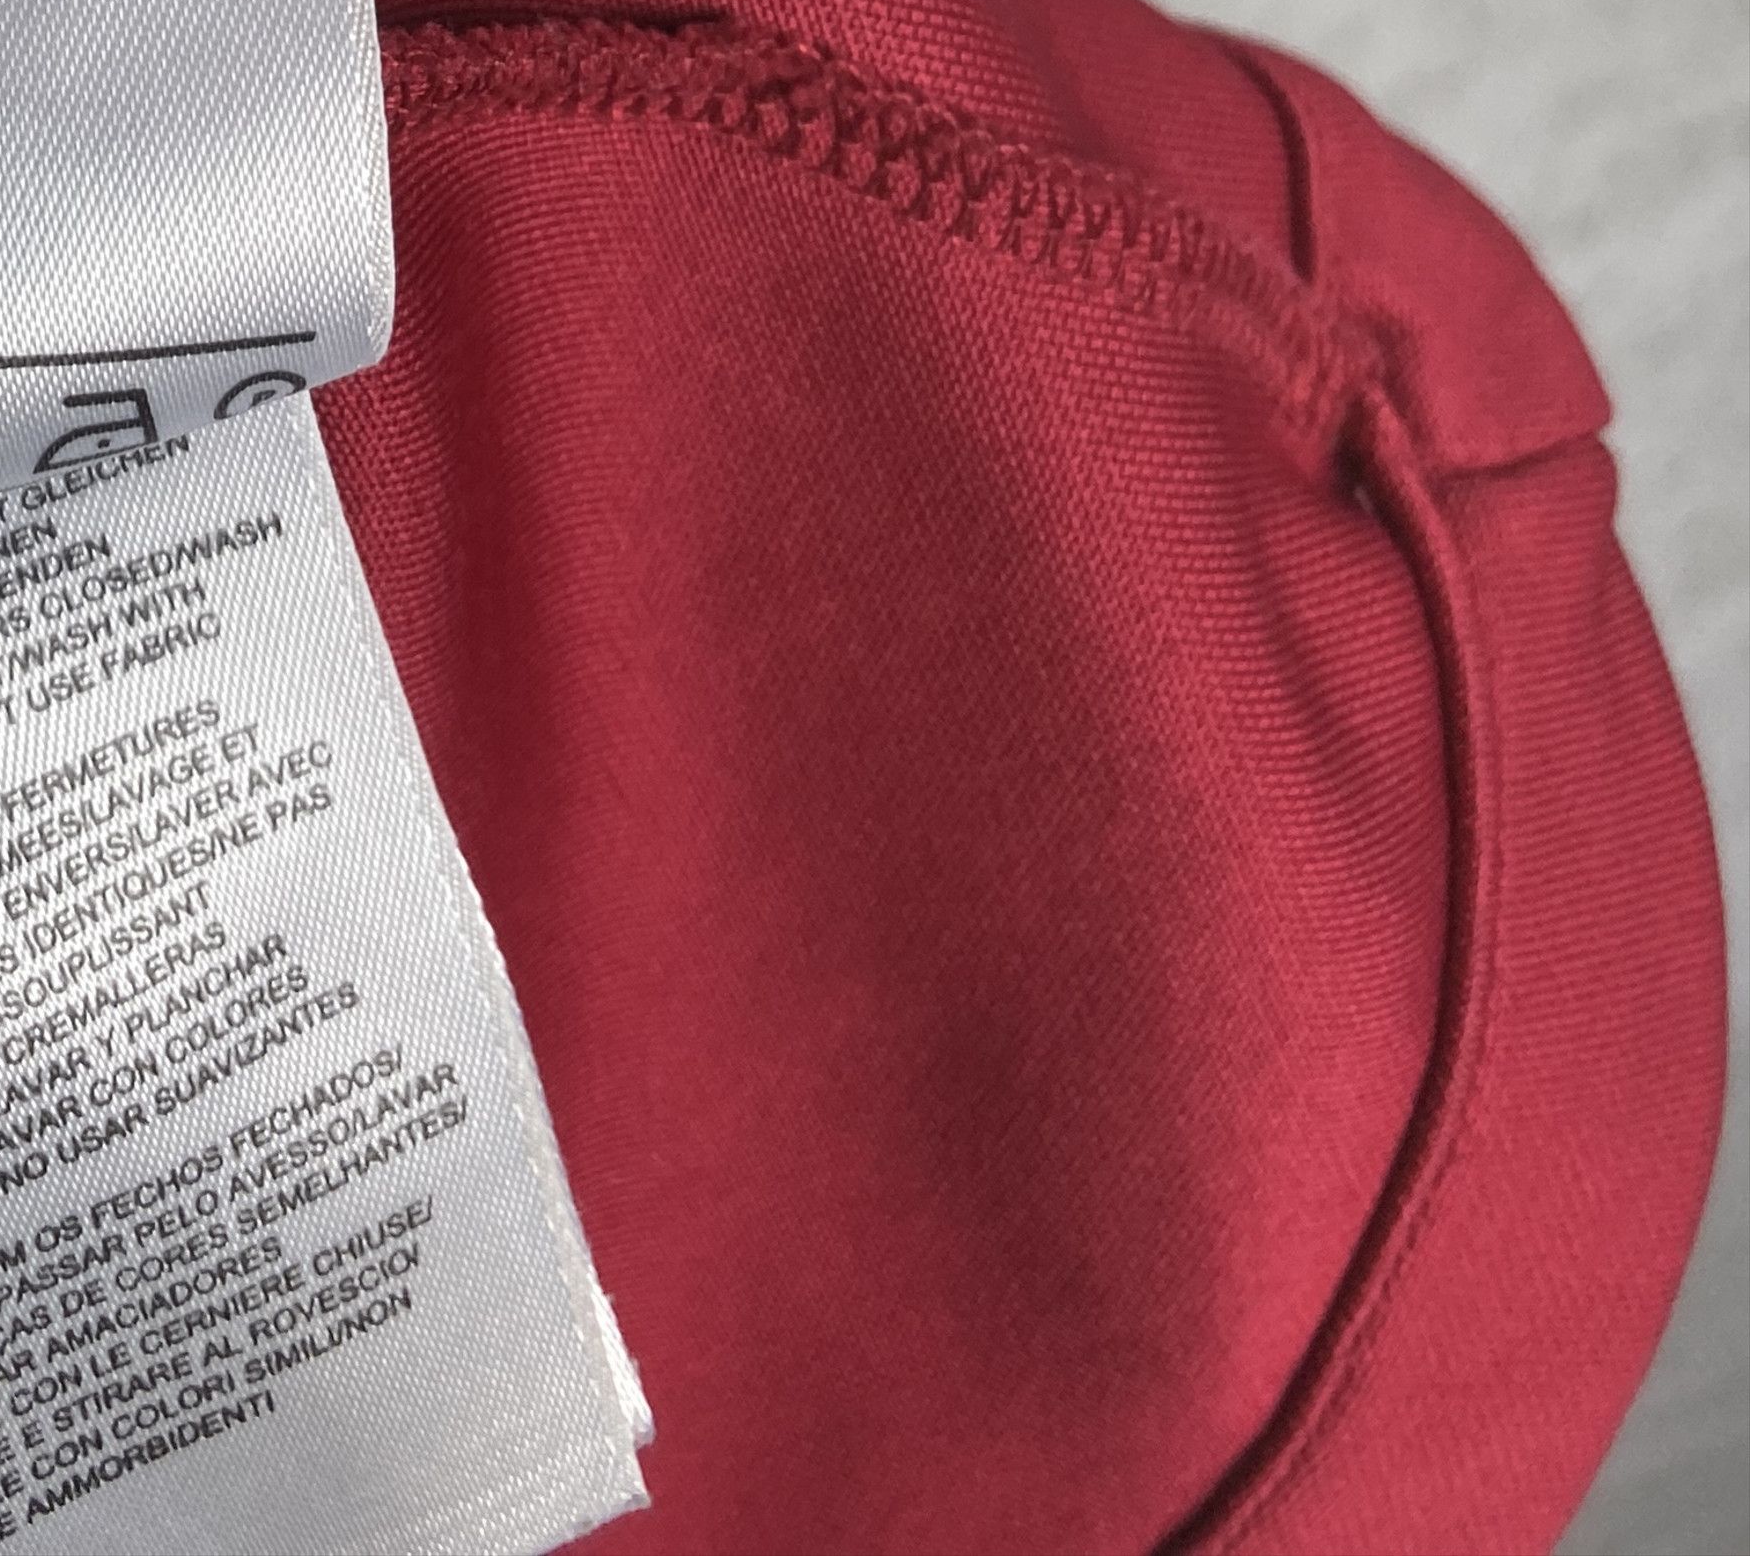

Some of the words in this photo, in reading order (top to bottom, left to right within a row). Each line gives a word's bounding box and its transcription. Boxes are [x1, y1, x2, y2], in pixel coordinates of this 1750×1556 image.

[26, 662, 95, 712] USE
[100, 611, 223, 679] FABRIC
[120, 577, 205, 627] WITH
[2, 698, 221, 820] FERMETURES
[243, 739, 333, 796] AVEC
[266, 782, 332, 830] PAS
[1, 921, 227, 1065] CREMALLERAS
[87, 1052, 158, 1107] CON
[164, 965, 309, 1065] COLORES
[125, 933, 286, 1041] PLANCHAR
[57, 1104, 147, 1165] USAR
[152, 981, 359, 1115] SUAVIZANTES
[33, 1214, 83, 1253] OS
[90, 1145, 224, 1227] FECHOS
[230, 1045, 407, 1156] FECHADOS/
[58, 1279, 106, 1316] DE
[114, 1222, 230, 1293] CORES
[235, 1095, 473, 1234] SEMELHANTES/
[135, 1188, 221, 1247] PELO
[225, 1062, 457, 1201] AVESSO/LAVAR
[8, 1365, 83, 1416] CON
[89, 1343, 131, 1376] LE
[138, 1264, 306, 1355] CERNIERE
[311, 1195, 437, 1276] CHIUSE/
[42, 1236, 282, 1362] AMACIADORES
[52, 1352, 194, 1432] STIRARE
[248, 1244, 424, 1344] ROVESCIO/
[29, 1429, 104, 1481] CON
[110, 1371, 235, 1440] COLORI
[242, 1288, 412, 1384] SIMILI/NON
[22, 1391, 275, 1523] AMMORBIDENTI
